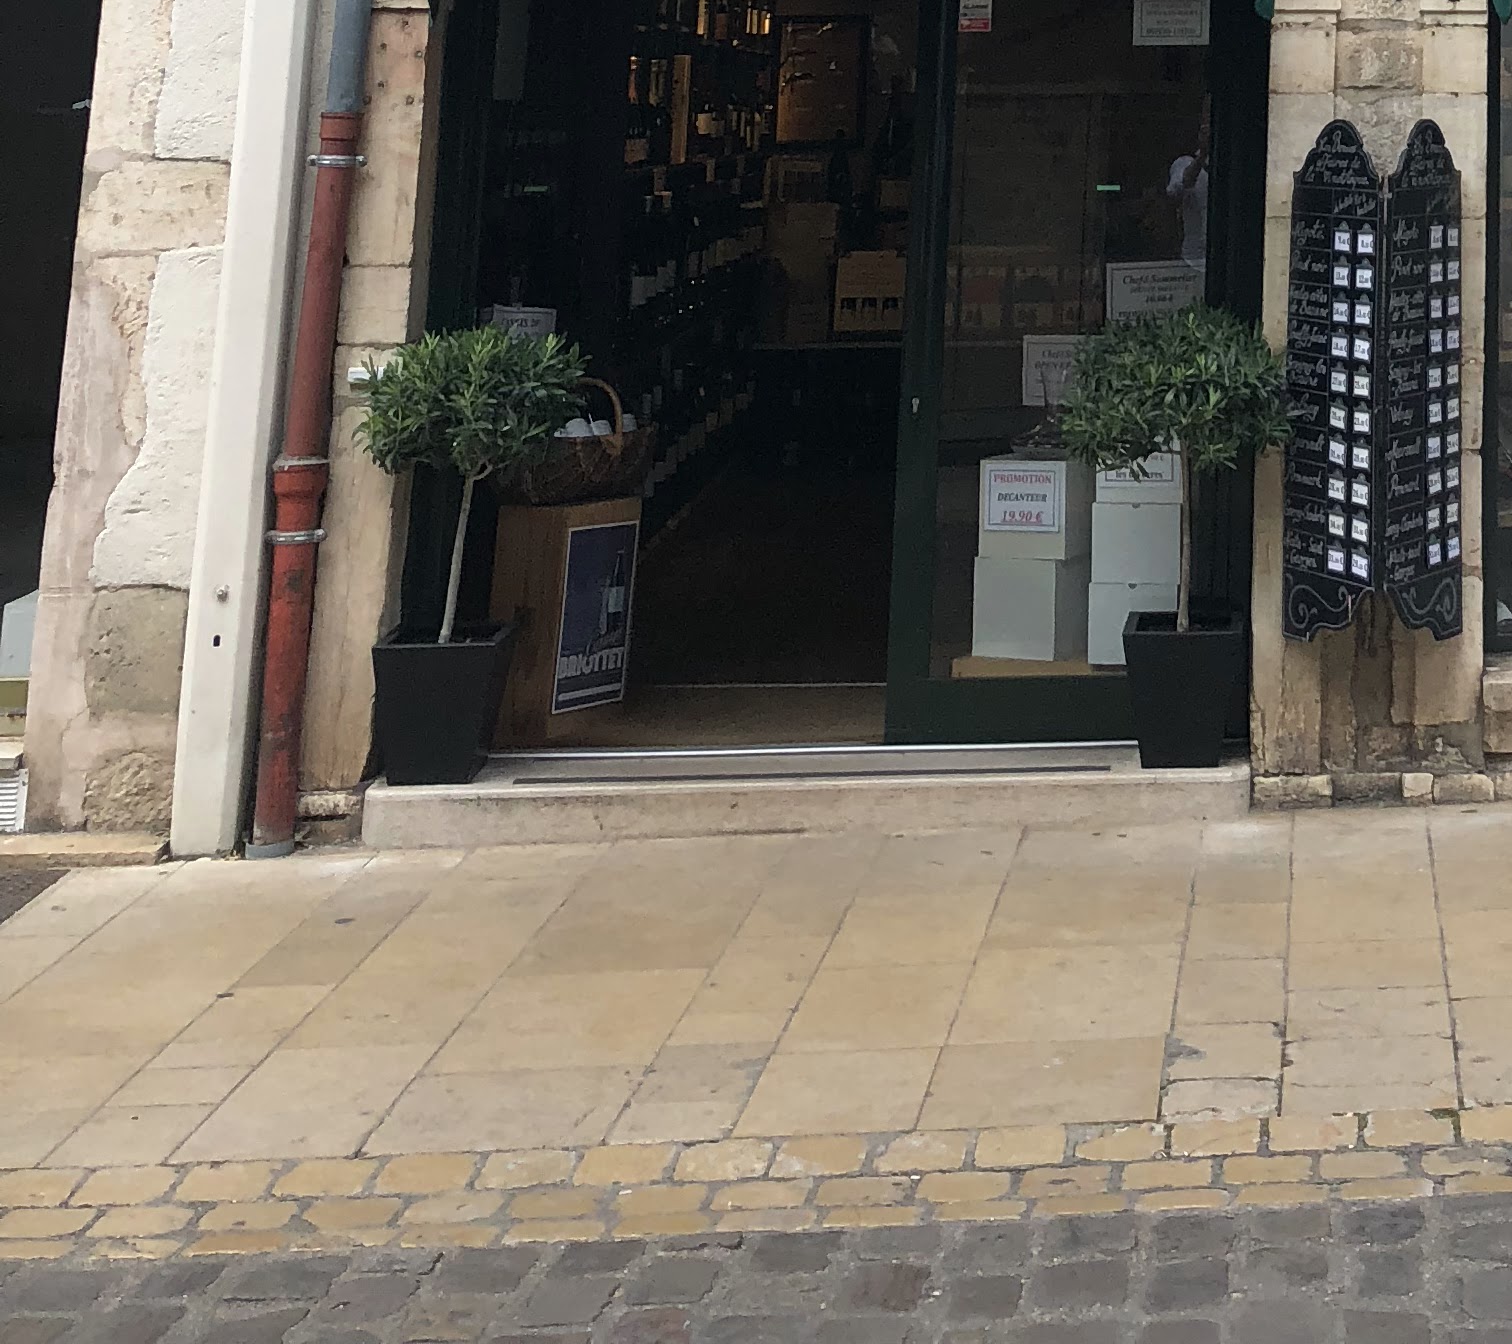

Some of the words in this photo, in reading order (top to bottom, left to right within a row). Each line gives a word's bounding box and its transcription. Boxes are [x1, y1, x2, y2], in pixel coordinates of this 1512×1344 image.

[993, 473, 1052, 484] PROMOTION
[997, 492, 1047, 502] DECANTEUR
[1003, 510, 1032, 523] 19.90
